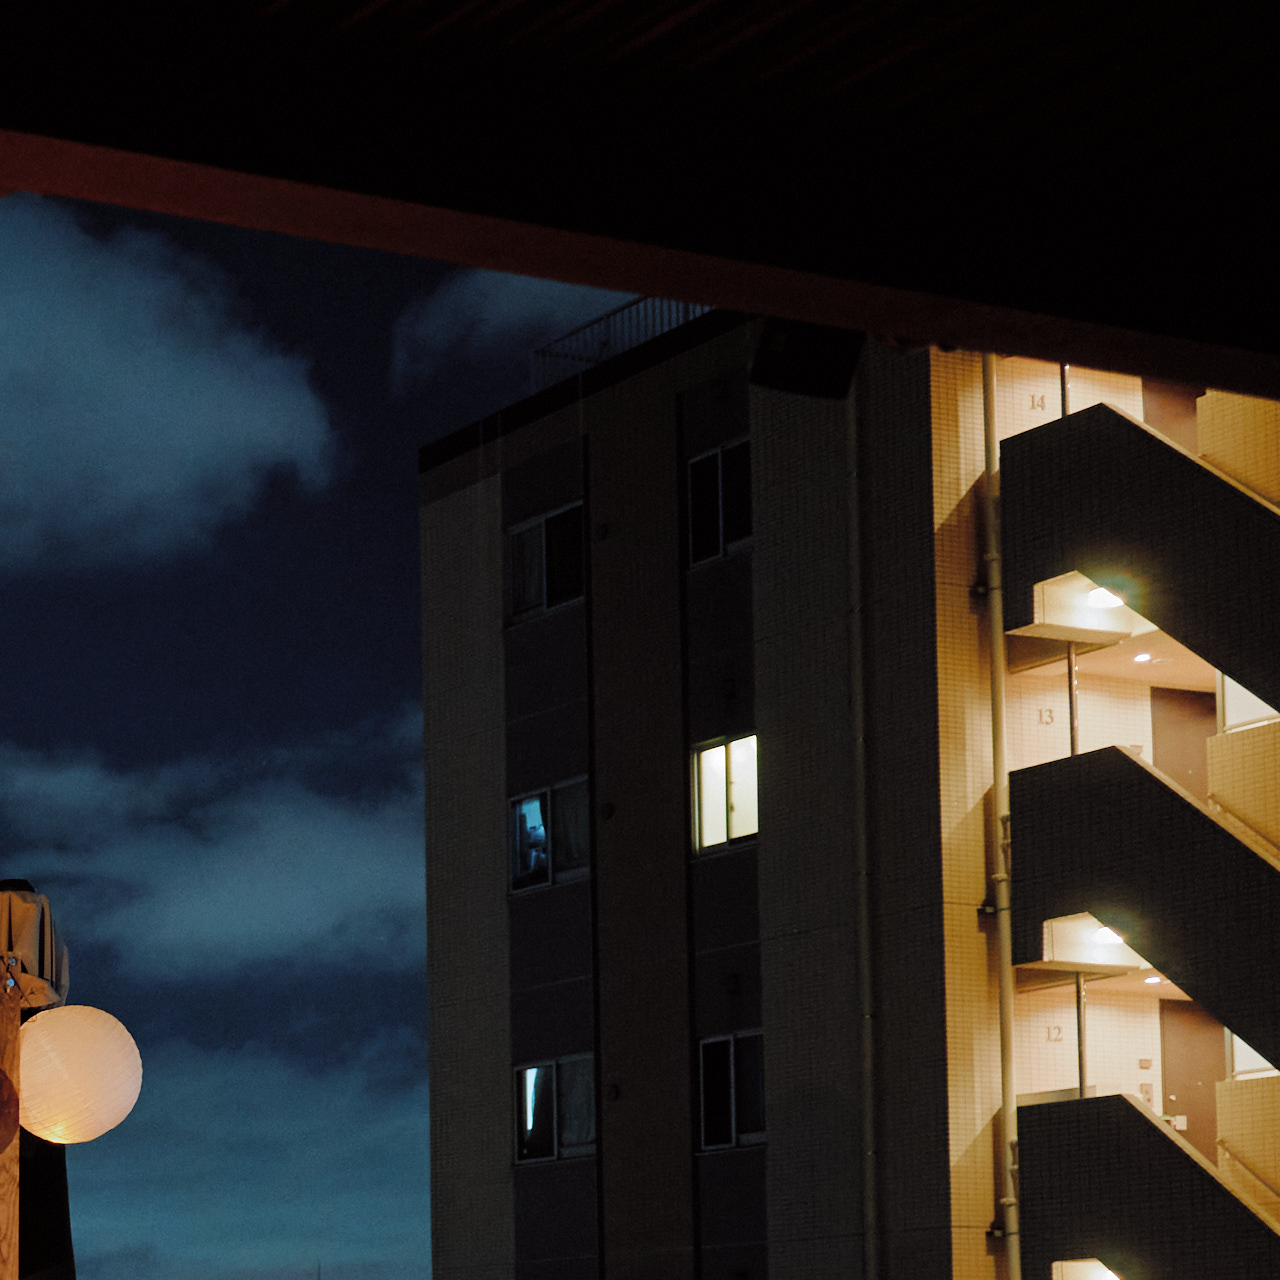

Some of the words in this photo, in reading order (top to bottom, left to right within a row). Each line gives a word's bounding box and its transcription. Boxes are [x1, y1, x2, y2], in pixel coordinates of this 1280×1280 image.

[1029, 394, 1046, 411] 14
[1038, 708, 1055, 725] 13
[1046, 1026, 1063, 1042] 12
